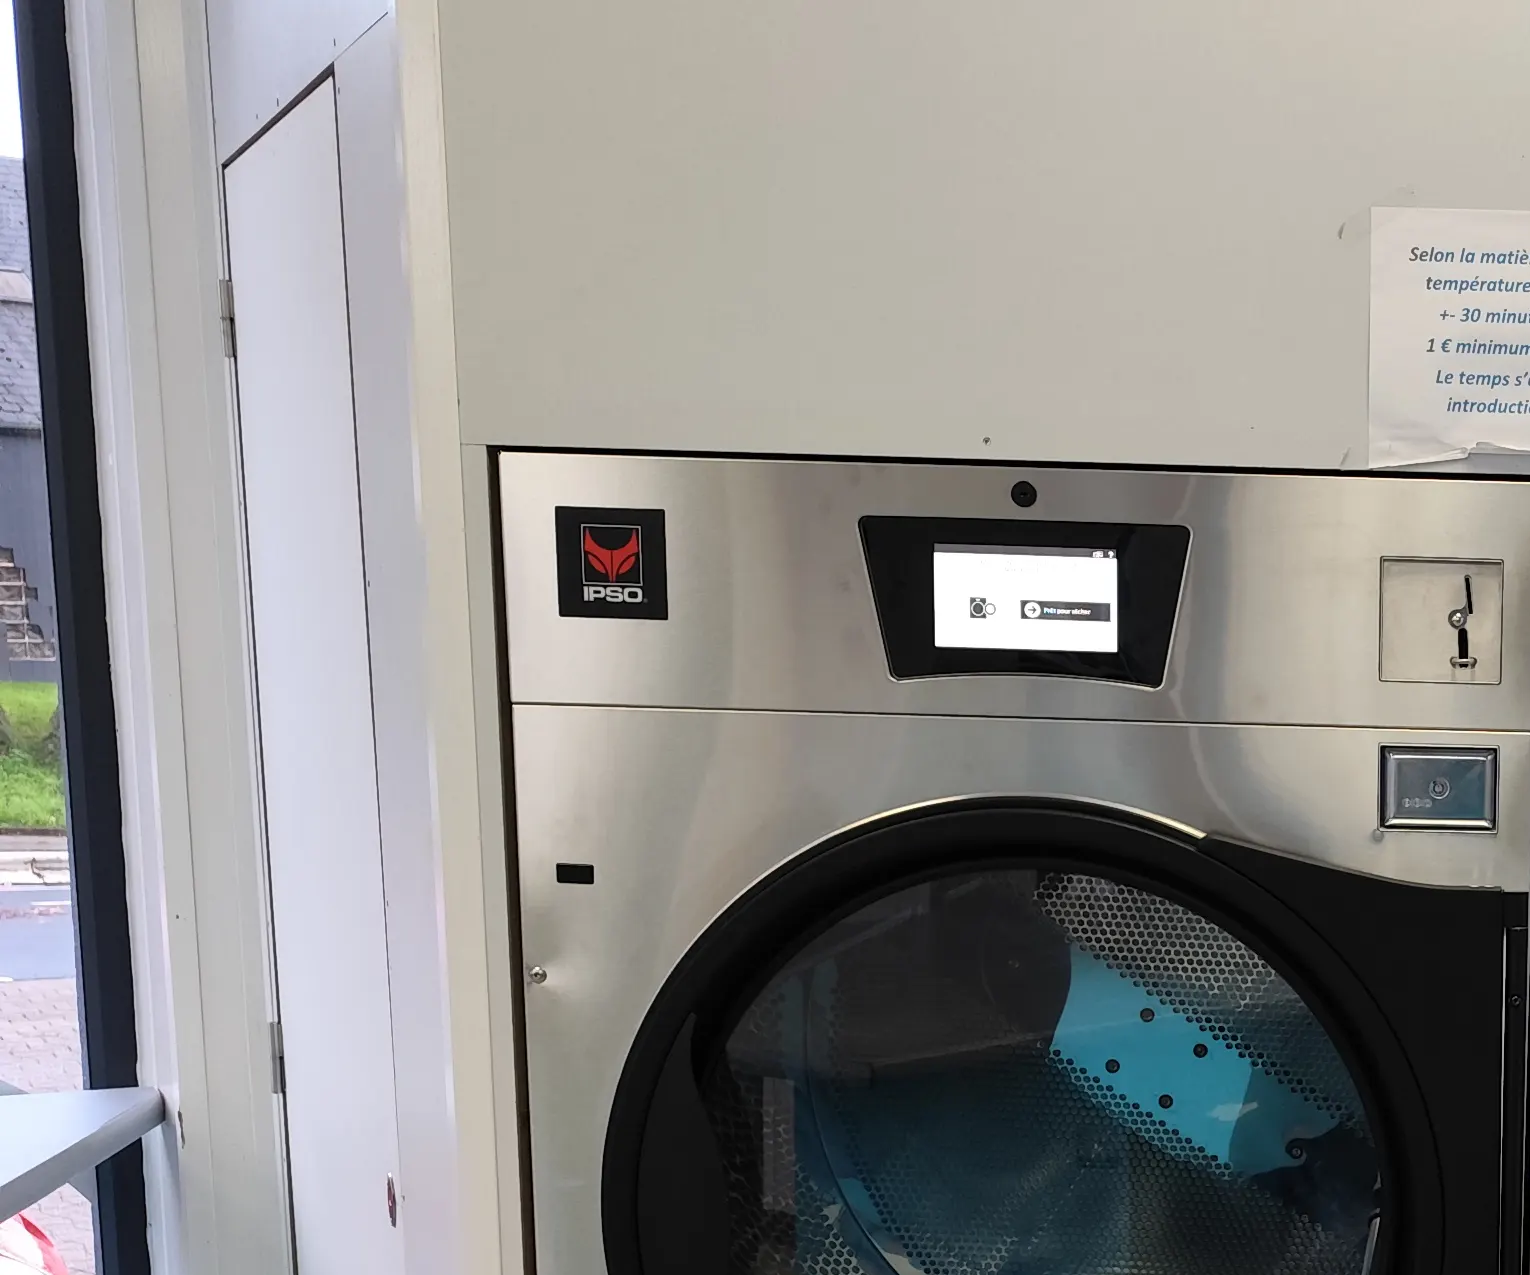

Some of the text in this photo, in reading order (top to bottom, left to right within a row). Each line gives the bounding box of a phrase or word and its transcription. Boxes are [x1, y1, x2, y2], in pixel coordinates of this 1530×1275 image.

[1408, 246, 1455, 263] Selon
[1459, 247, 1476, 264] la
[1439, 309, 1456, 321] +-
[1459, 307, 1482, 323] 30
[1426, 337, 1436, 353] 1
[1440, 338, 1453, 353] €
[1435, 369, 1454, 385] Le
[1458, 371, 1511, 390] temps
[583, 585, 643, 603] IPSO
